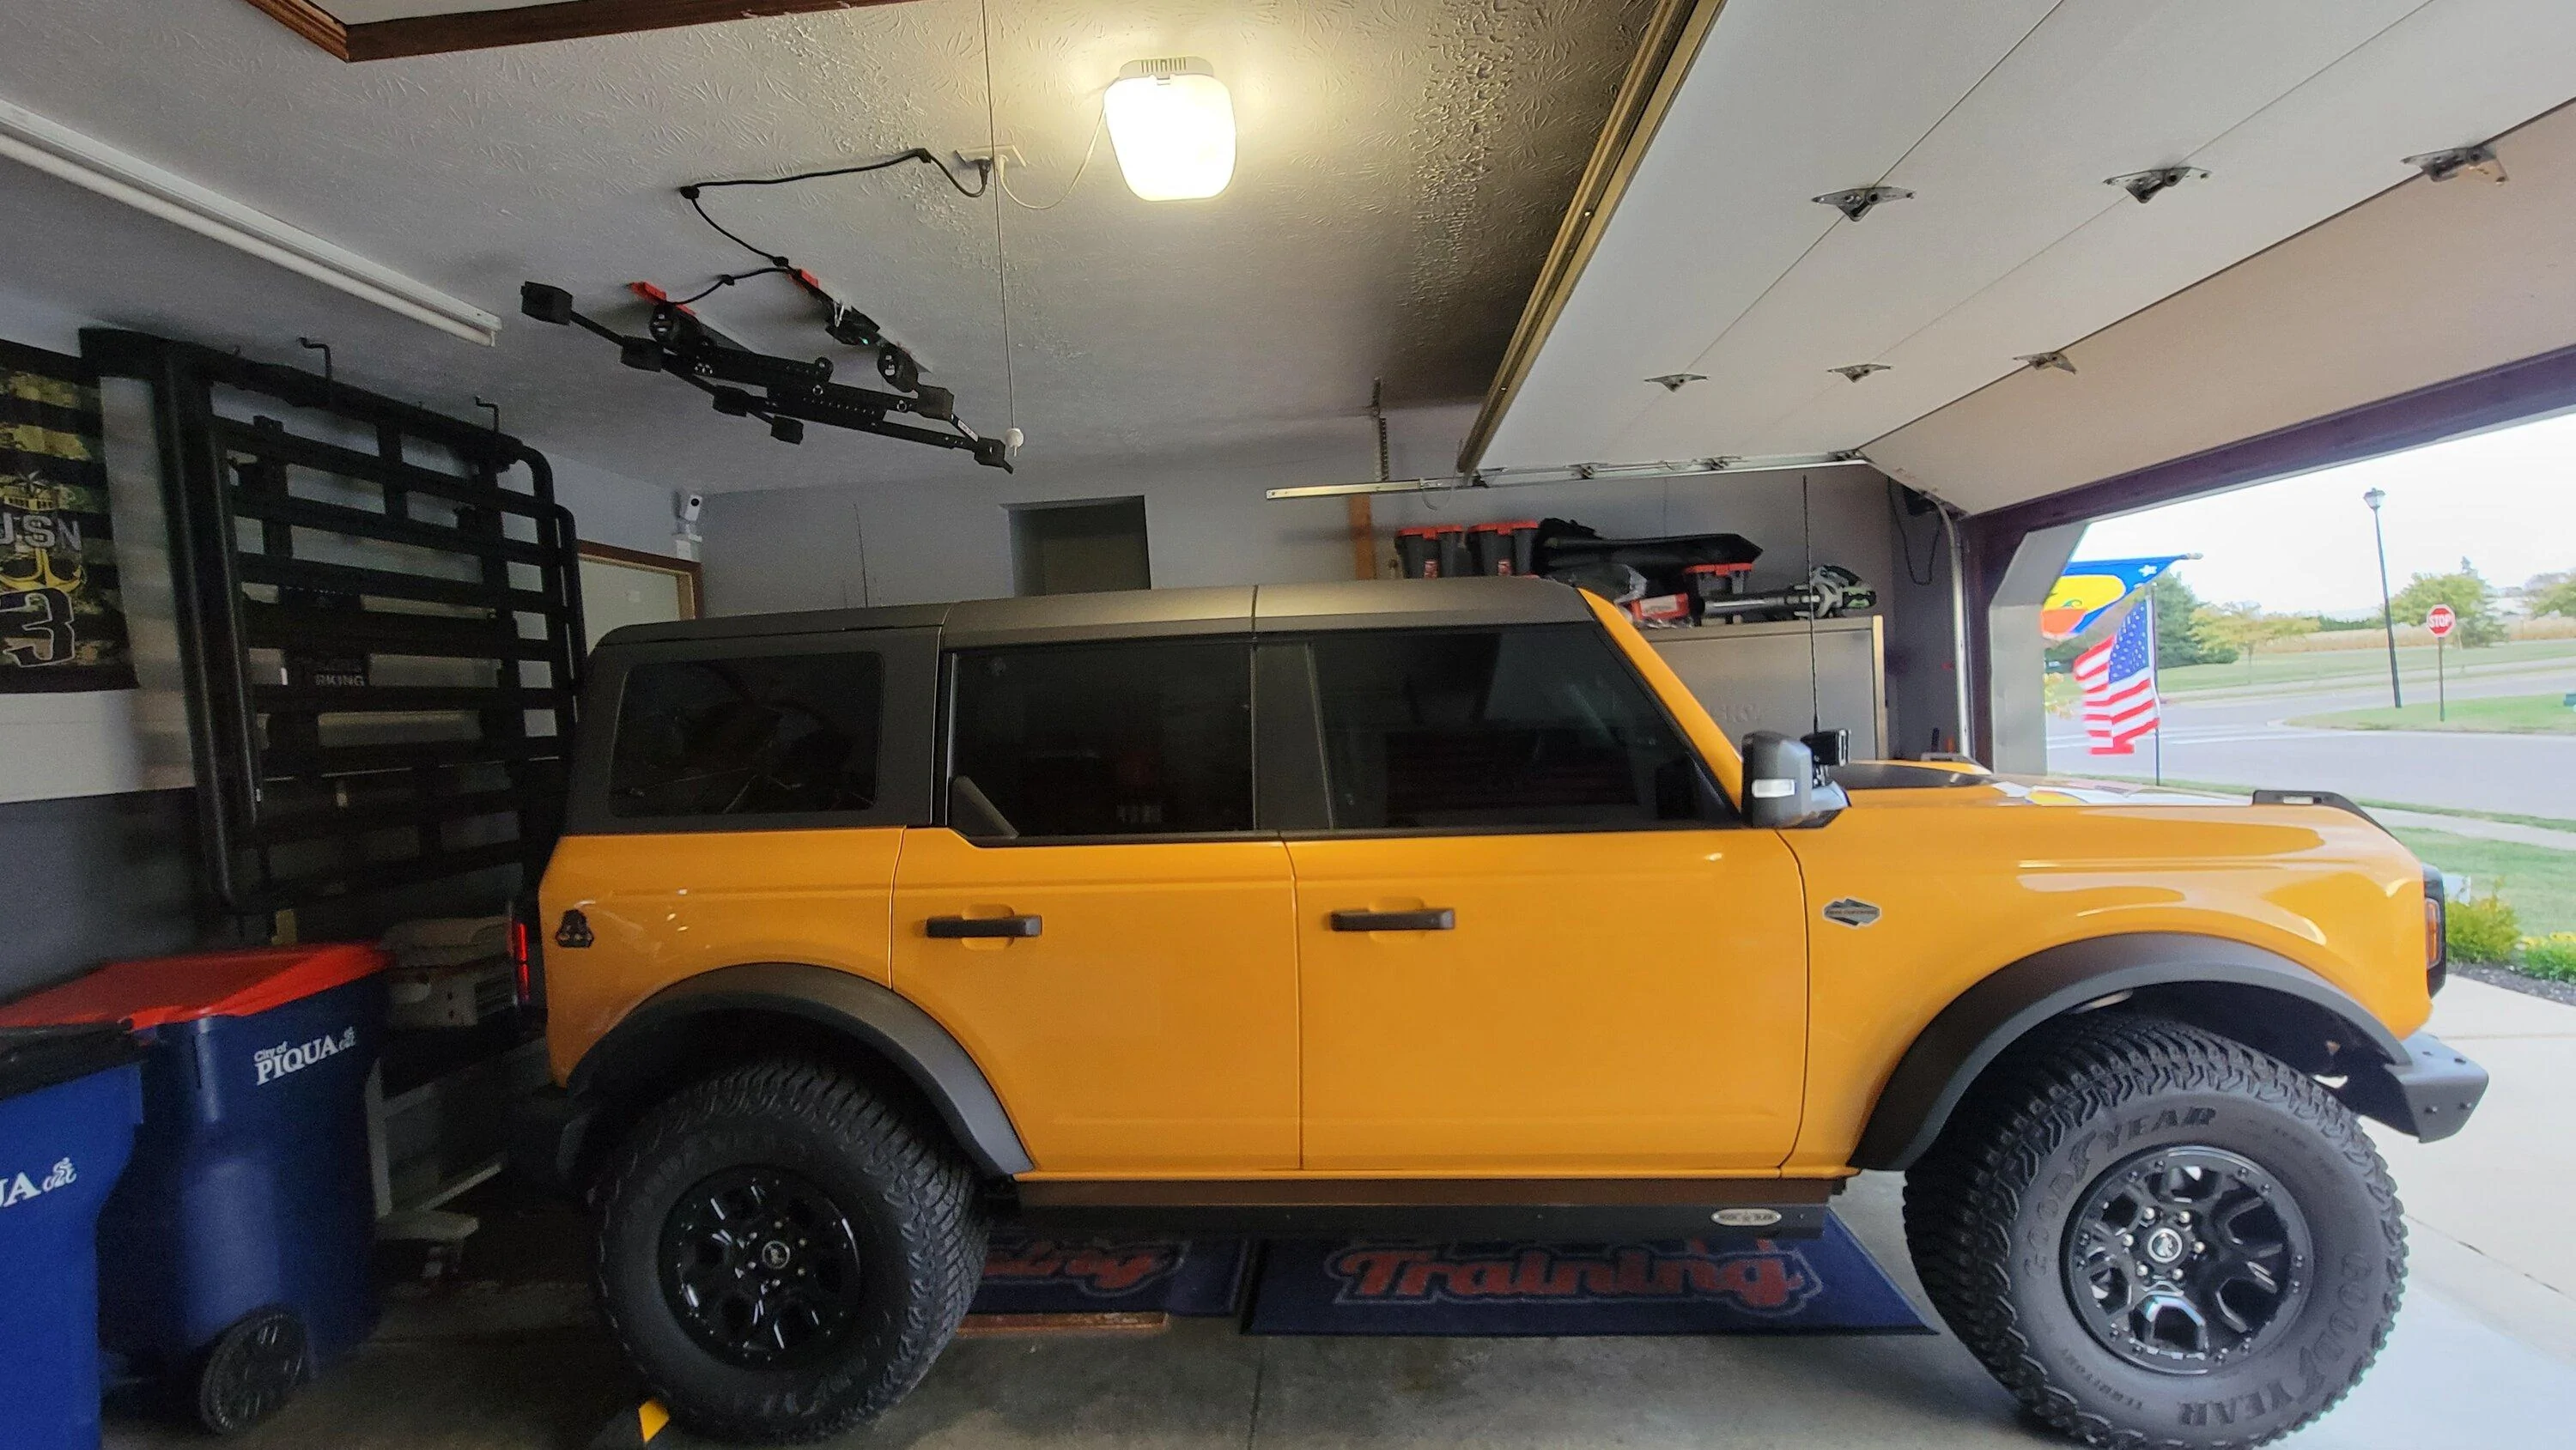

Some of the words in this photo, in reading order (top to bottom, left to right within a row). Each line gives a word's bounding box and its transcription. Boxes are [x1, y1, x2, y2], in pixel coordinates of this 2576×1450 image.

[2428, 613, 2452, 628] STOP
[254, 1048, 276, 1063] City
[276, 1040, 289, 1055] of
[254, 1034, 339, 1086] PIQUA
[1337, 1250, 1805, 1307] Training
